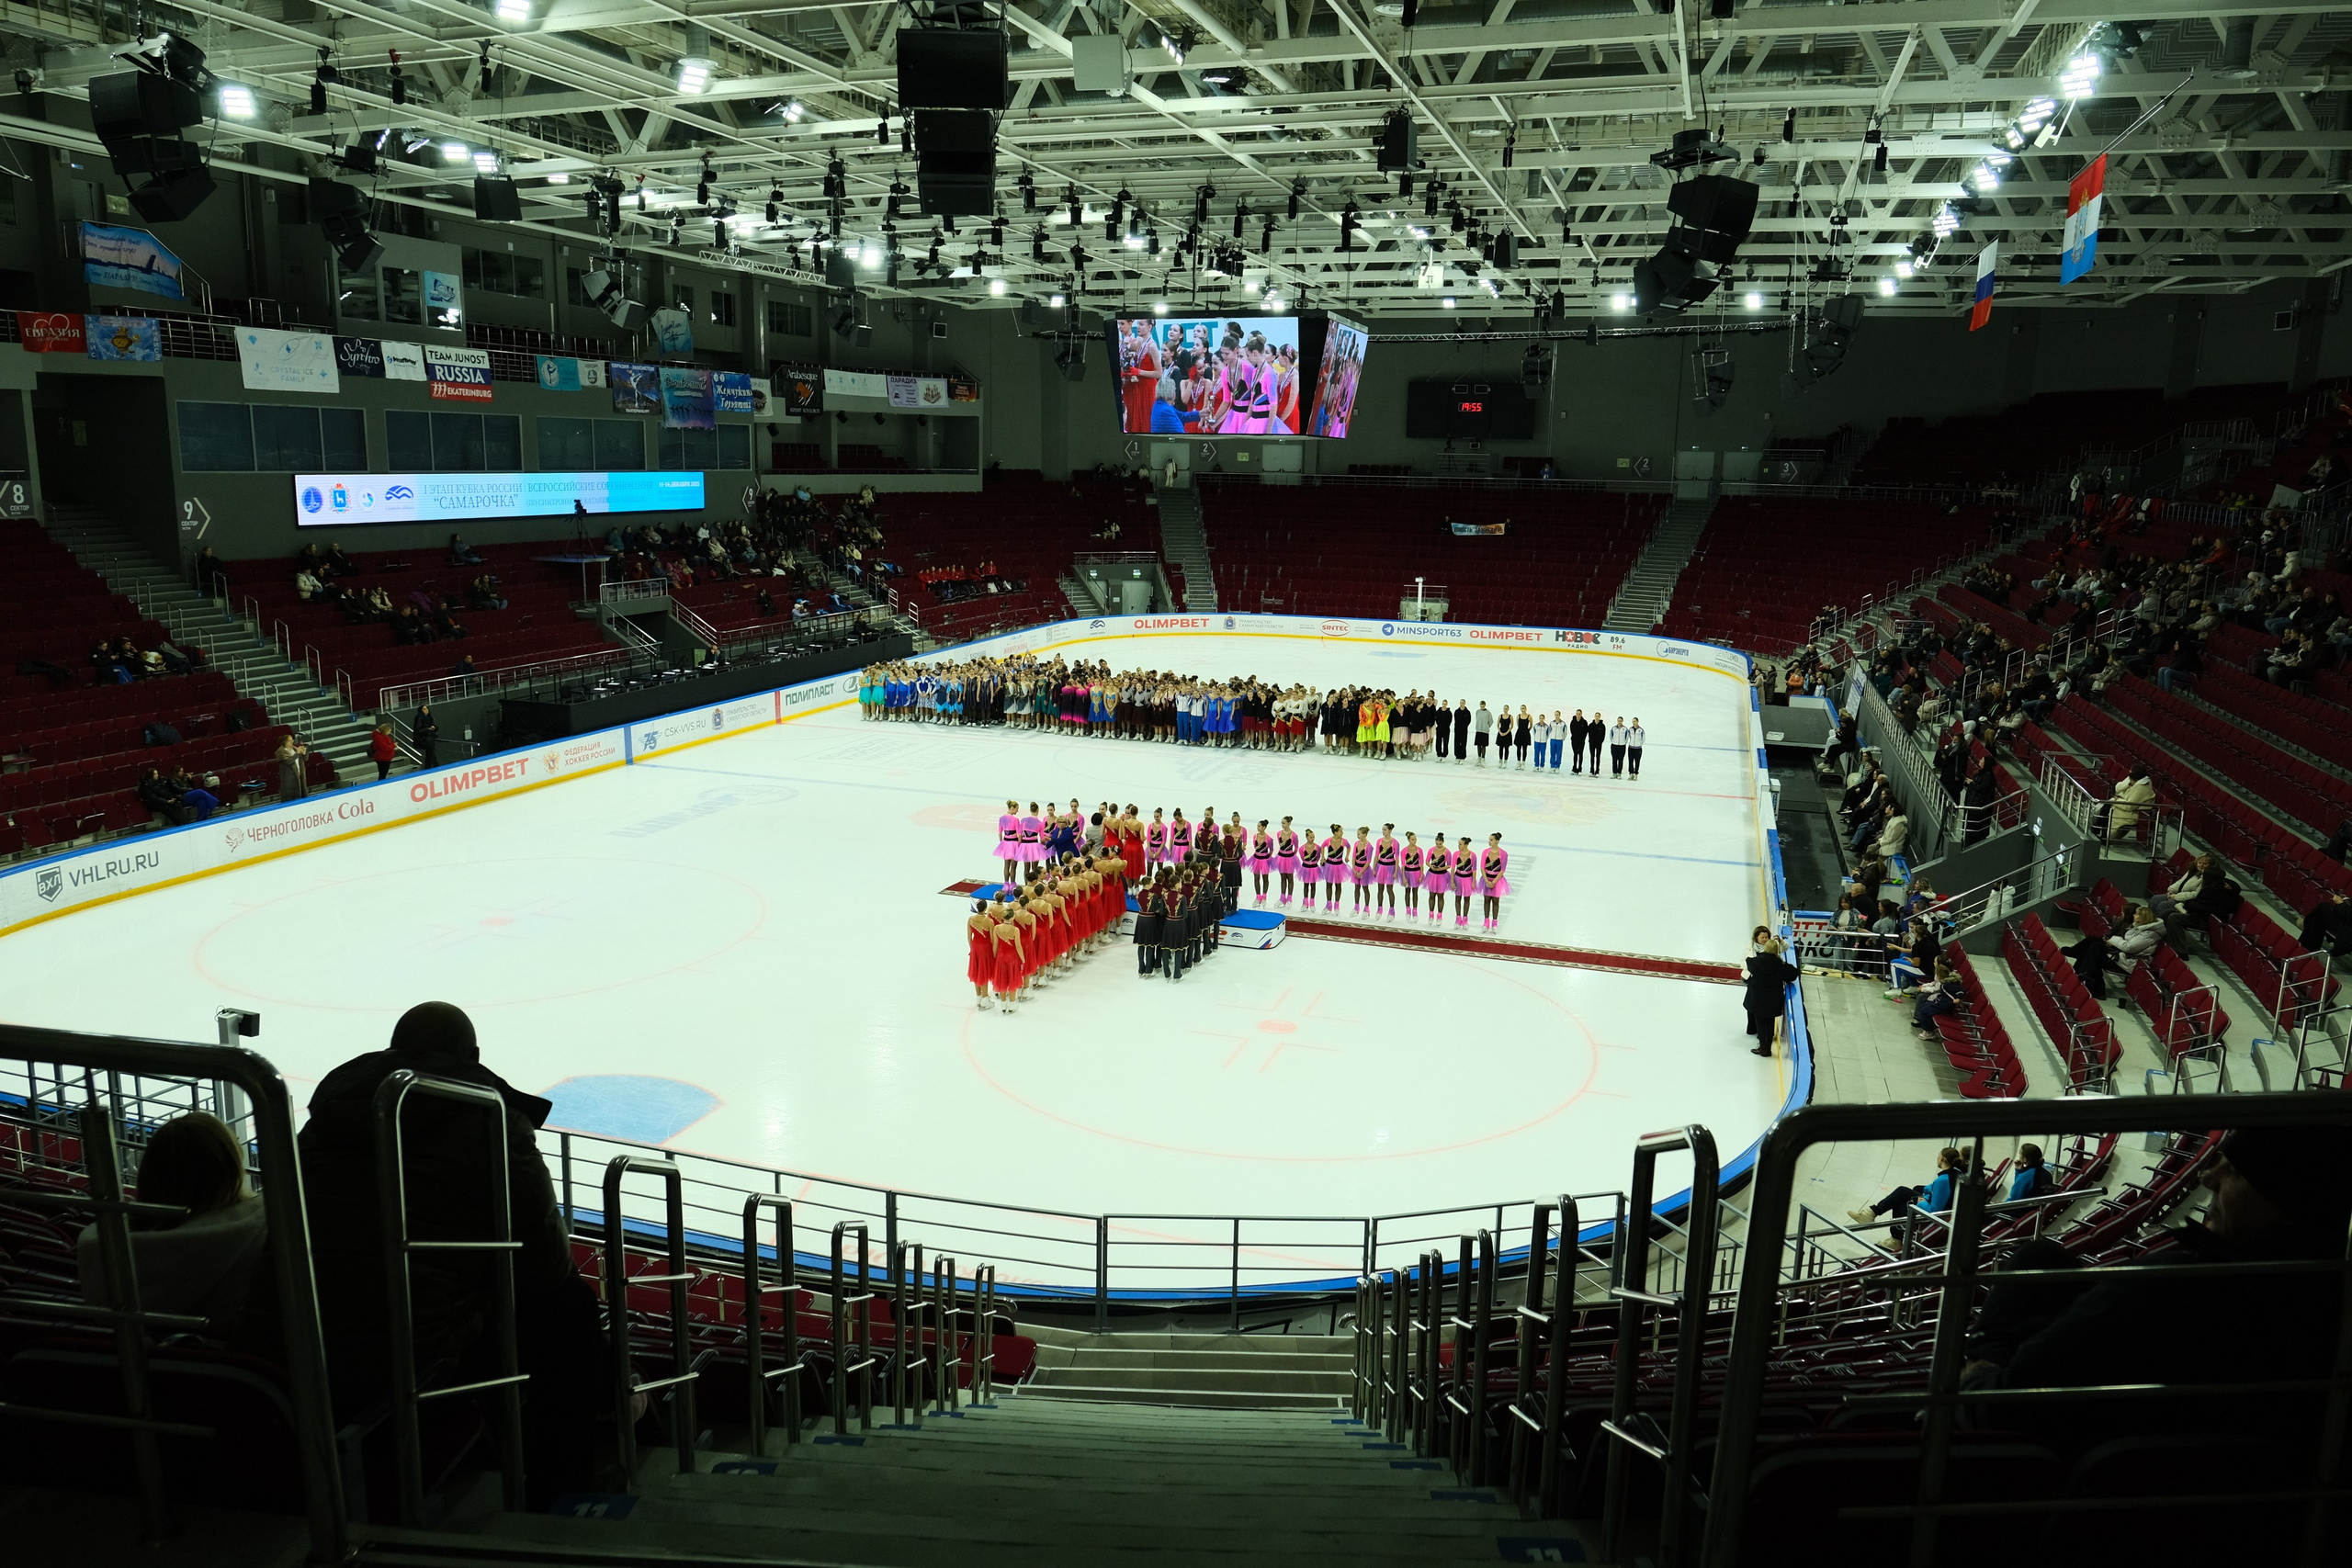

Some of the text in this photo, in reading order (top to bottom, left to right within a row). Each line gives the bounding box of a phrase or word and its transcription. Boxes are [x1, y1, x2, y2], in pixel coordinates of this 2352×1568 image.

[26, 328, 80, 339] ЕВРАЗИЯ
[428, 350, 486, 366] TEAM JUNOST
[435, 366, 485, 384] RUSSIA
[786, 368, 819, 382] Arabesque
[447, 388, 492, 399] EKATERINBURG
[1461, 402, 1483, 412] 19:55
[1203, 443, 1208, 453] 2
[1643, 458, 1649, 468] 2
[1783, 463, 1790, 473] 3
[430, 484, 454, 495] ЭТАП
[456, 483, 486, 494] КУБКА
[487, 482, 523, 493] РОССИИ
[528, 480, 653, 492] ВСЕРОССИЙСКИЕ СОРЕВНОВАНИЯ
[13, 484, 25, 504] 8
[749, 488, 753, 500] 9
[184, 501, 193, 520] 9
[1134, 617, 1210, 629] OLIMPBET
[1397, 626, 1462, 638] MINSPORT63
[1469, 629, 1544, 642] OLIMPBET
[1610, 636, 1626, 644] 89.6
[786, 682, 835, 705] ПОЛИПЛАСТ
[664, 720, 707, 738] CSK-VVS.RU
[564, 741, 601, 756] ФЕДЕРАЦИЯ
[565, 747, 616, 766] ХОККЕЯ РОССИИ
[410, 757, 530, 803] OLIMPBET
[247, 798, 375, 842] ЧЕРНОГОЛОВКА Cola
[69, 851, 161, 888] VHLRU.RU
[38, 874, 62, 897] ВХЛ
